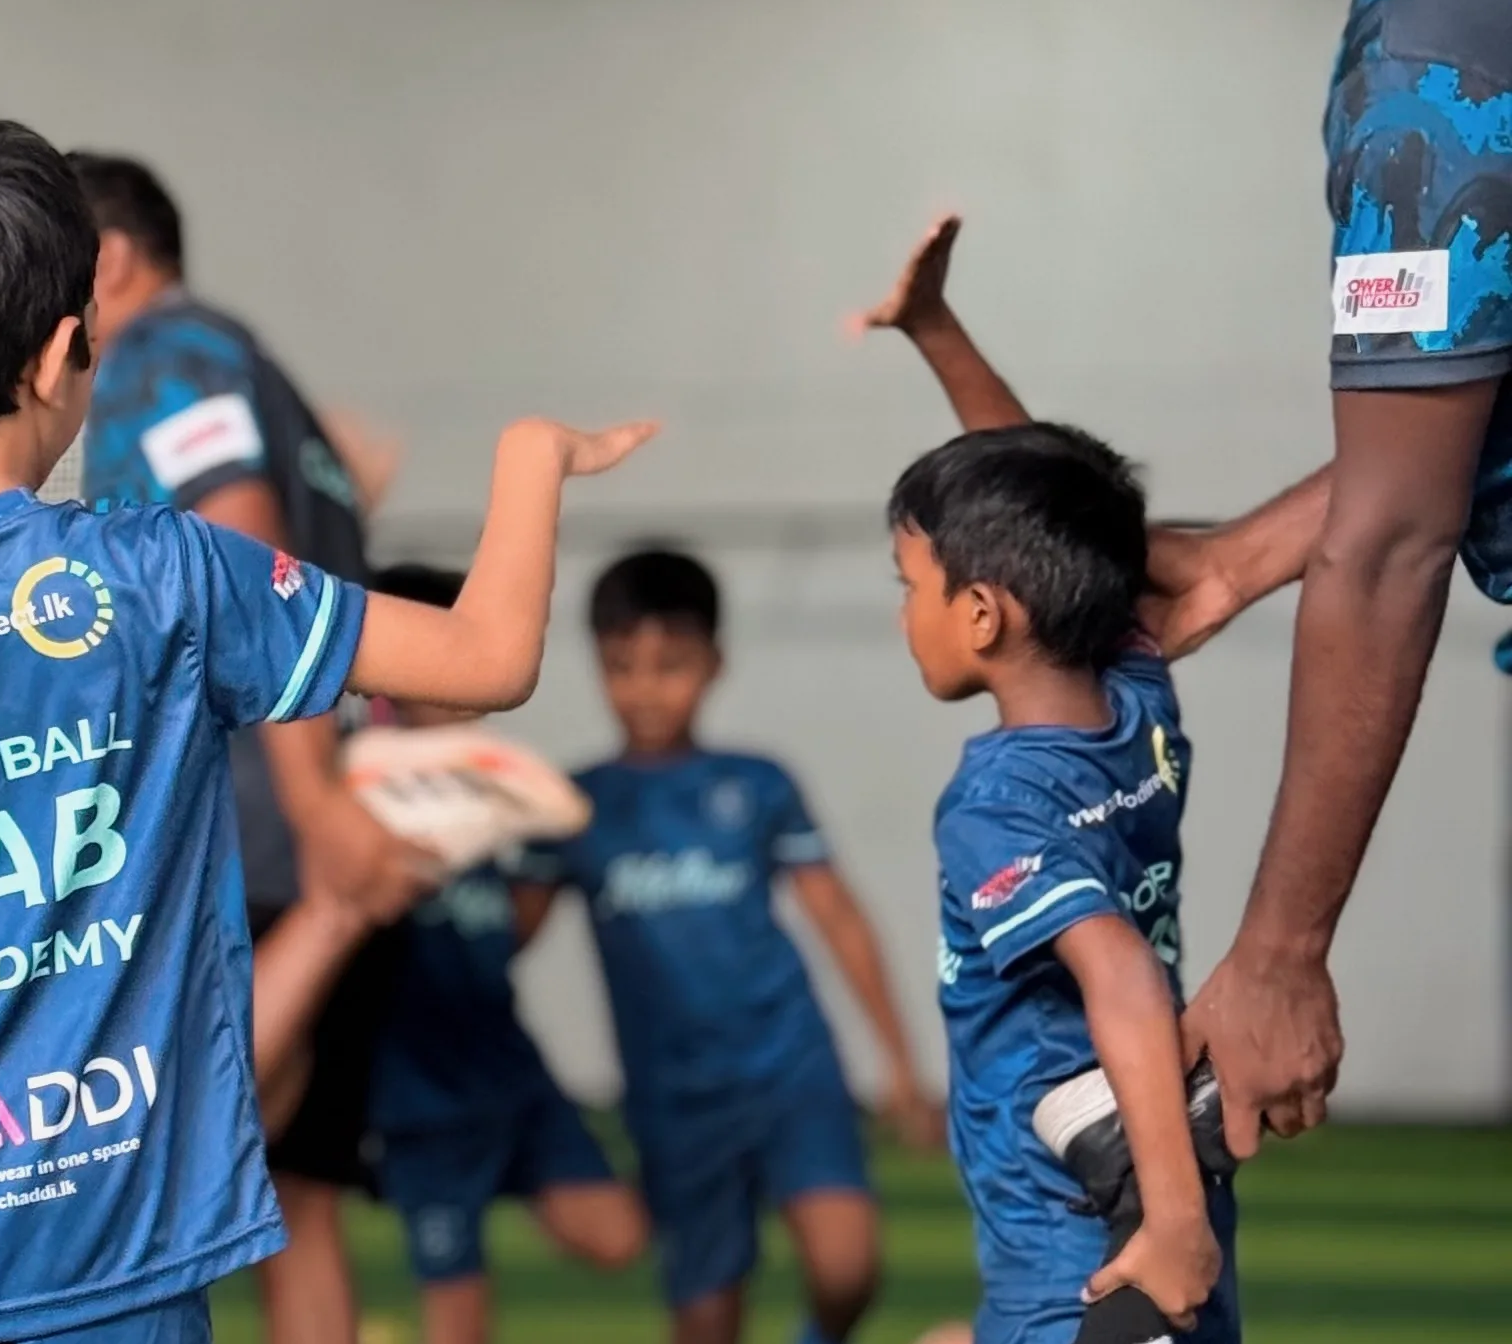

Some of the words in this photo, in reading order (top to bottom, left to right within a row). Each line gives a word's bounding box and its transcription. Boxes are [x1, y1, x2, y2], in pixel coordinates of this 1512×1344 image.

[1360, 293, 1418, 307] WORLD
[37, 1159, 55, 1175] in
[57, 1151, 89, 1170] one
[91, 1137, 141, 1163] space
